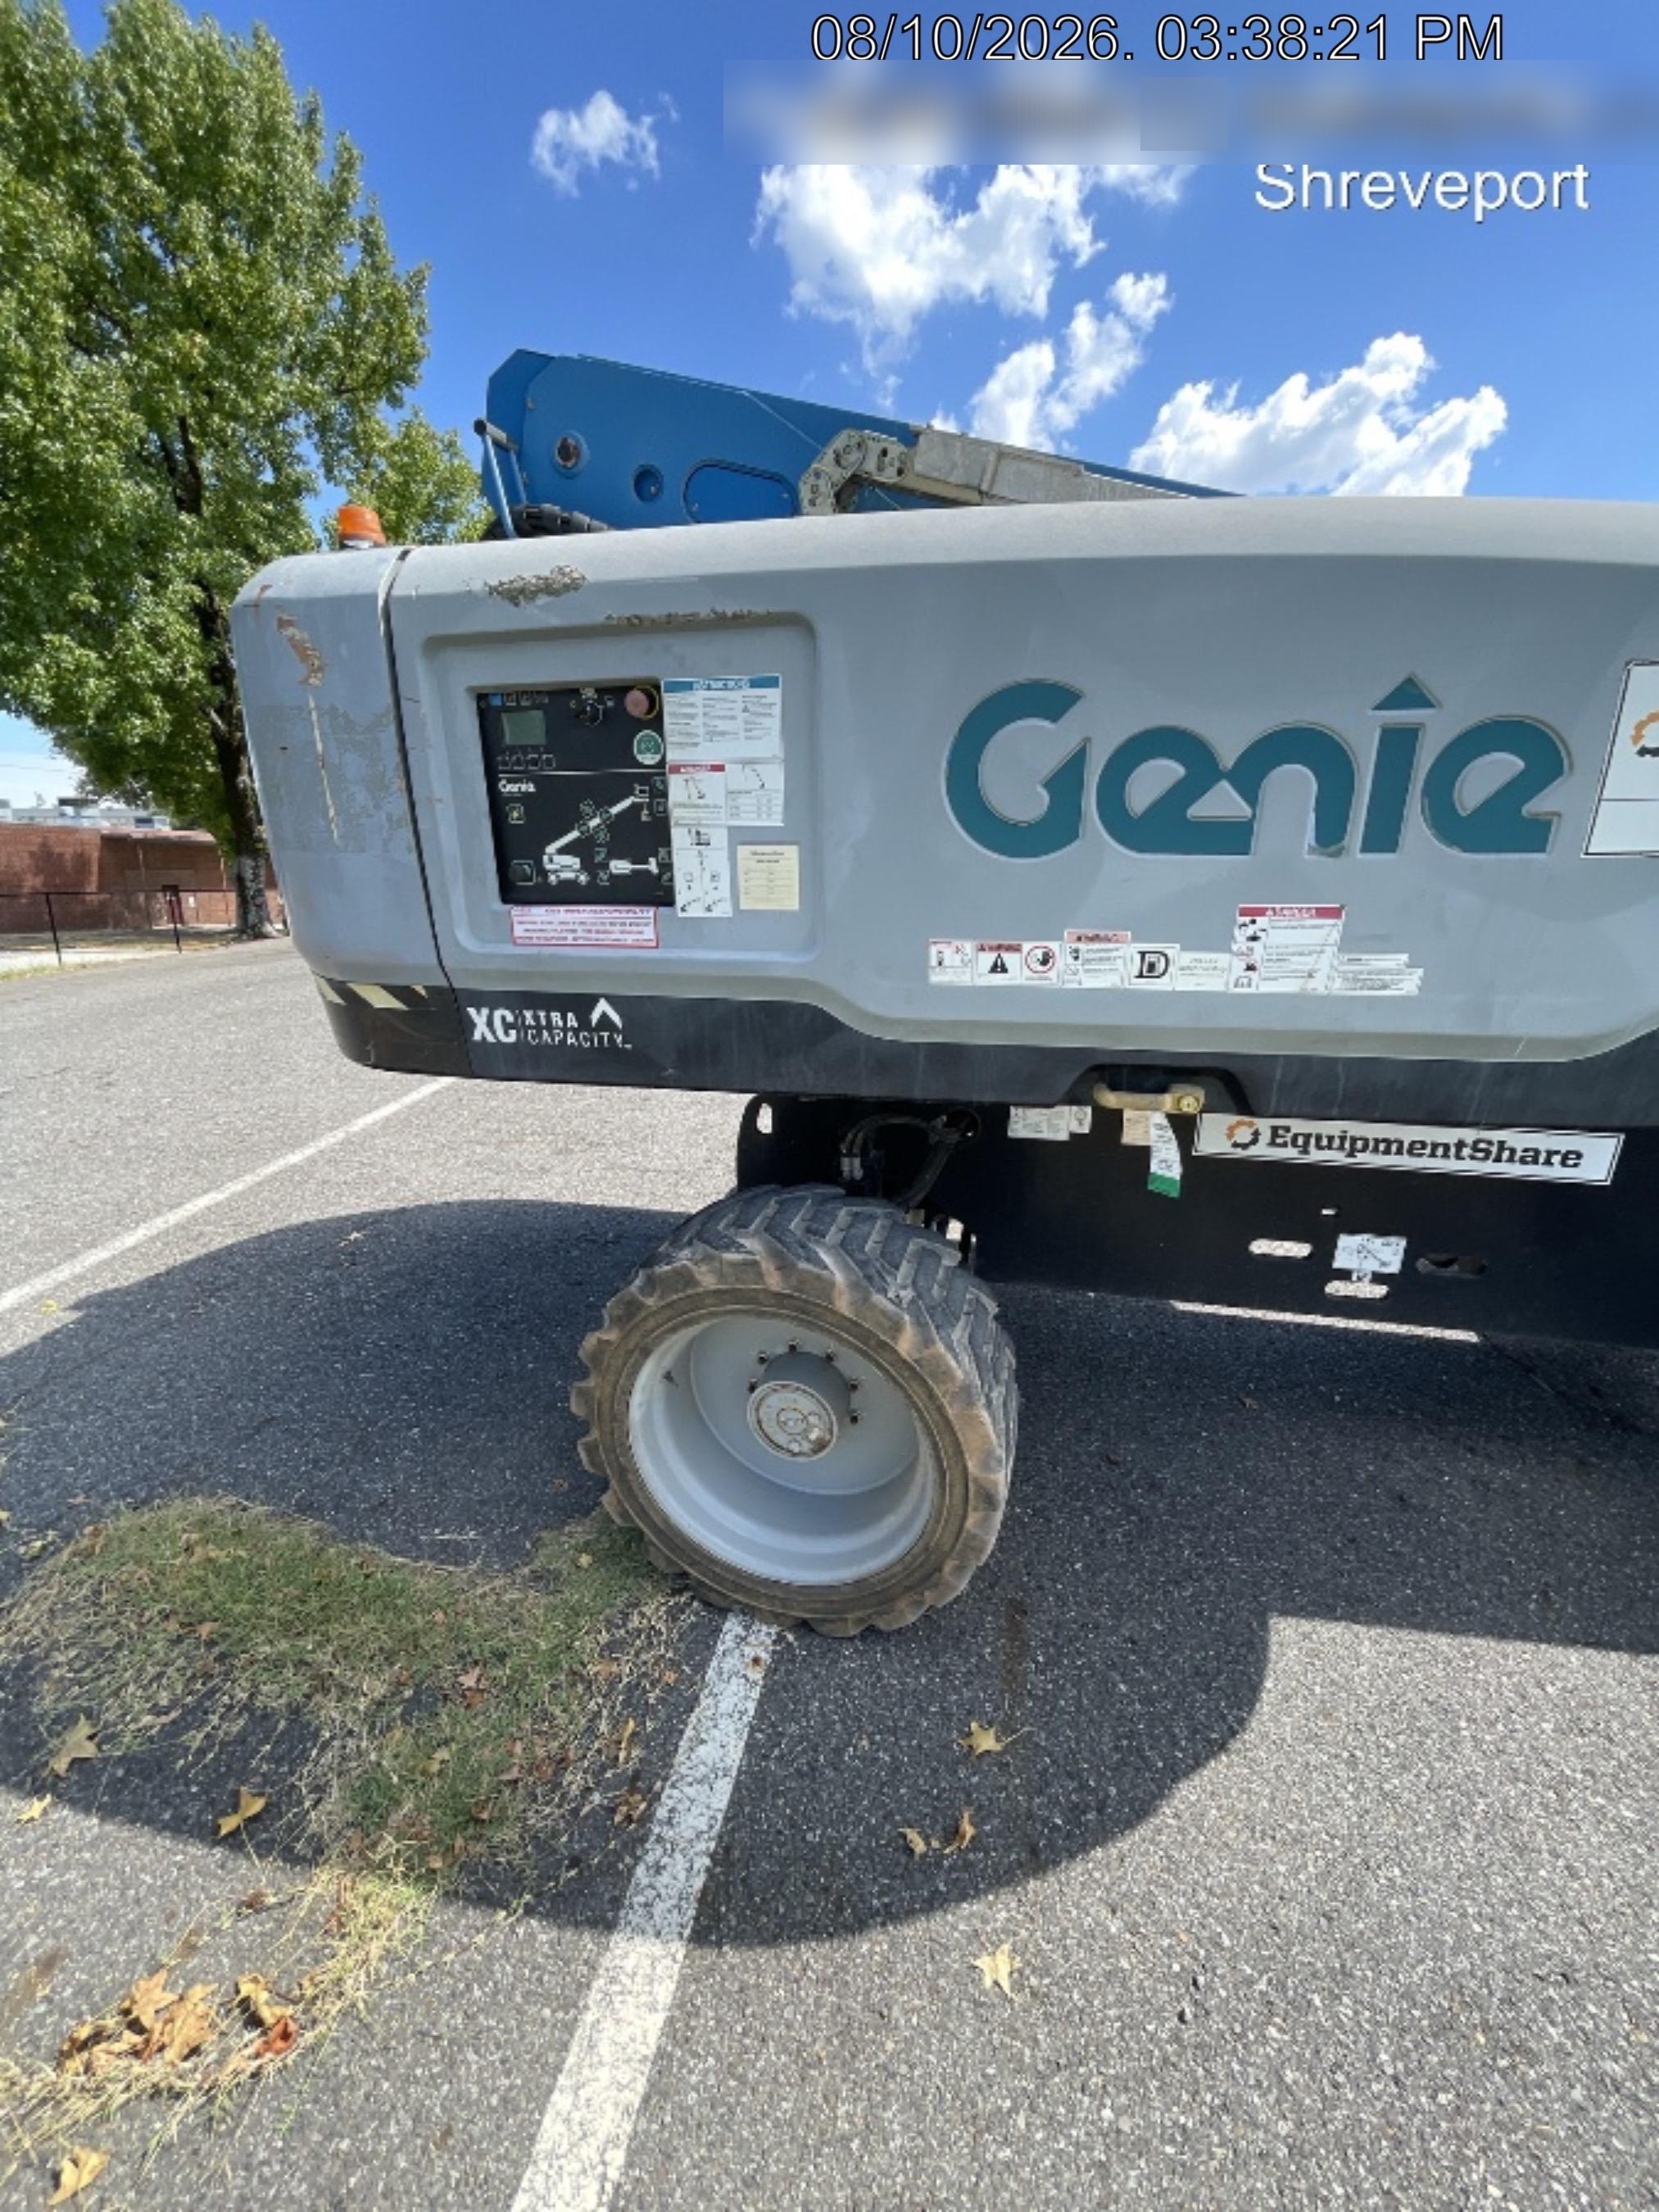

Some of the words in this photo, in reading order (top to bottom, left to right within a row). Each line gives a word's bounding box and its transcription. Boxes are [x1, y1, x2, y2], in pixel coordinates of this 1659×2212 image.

[942, 672, 1574, 862] Genie
[466, 1007, 517, 1043] XC
[522, 1009, 578, 1029] XTRA
[527, 1029, 624, 1049] CAPACITY
[1266, 1125, 1584, 1169] EquipmentShare
